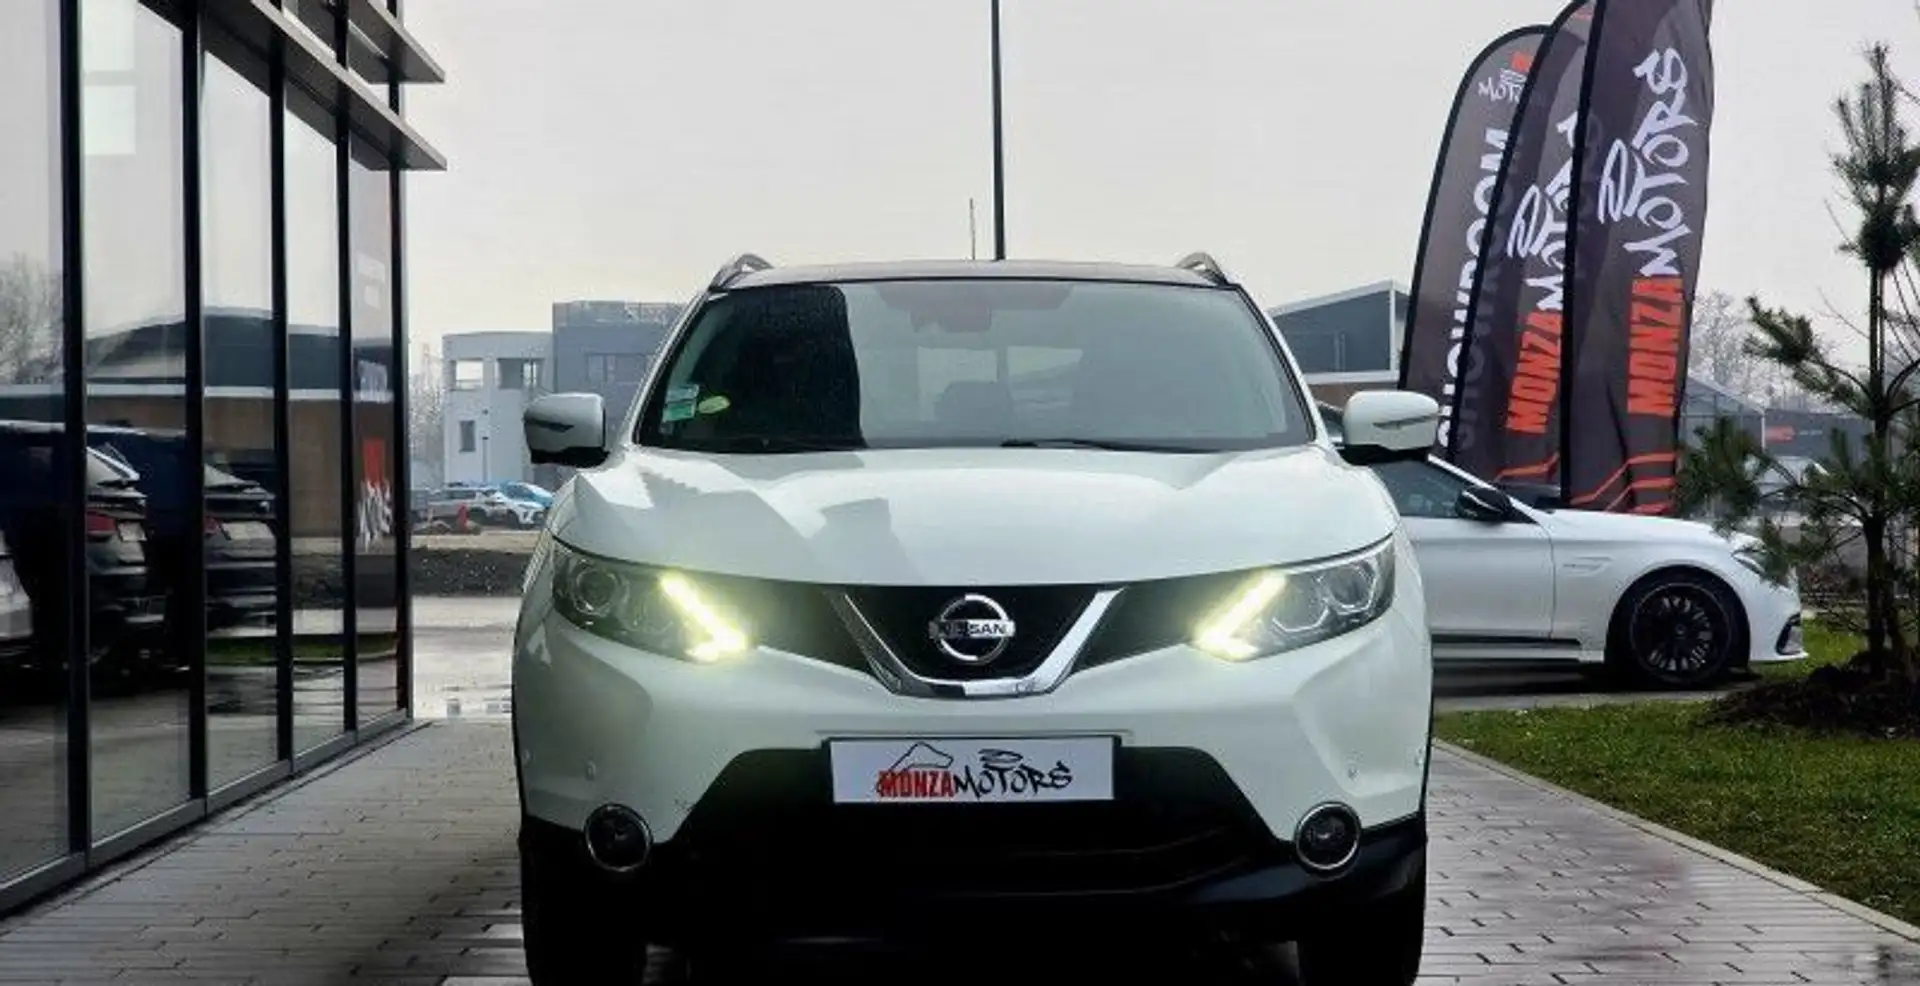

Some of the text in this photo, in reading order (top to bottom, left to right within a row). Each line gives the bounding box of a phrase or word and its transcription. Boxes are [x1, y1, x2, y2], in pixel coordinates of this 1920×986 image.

[1622, 48, 1699, 416] MONZA MOTORS
[1504, 310, 1563, 433] MONZA
[876, 760, 1073, 800] MONZA MOTORS
